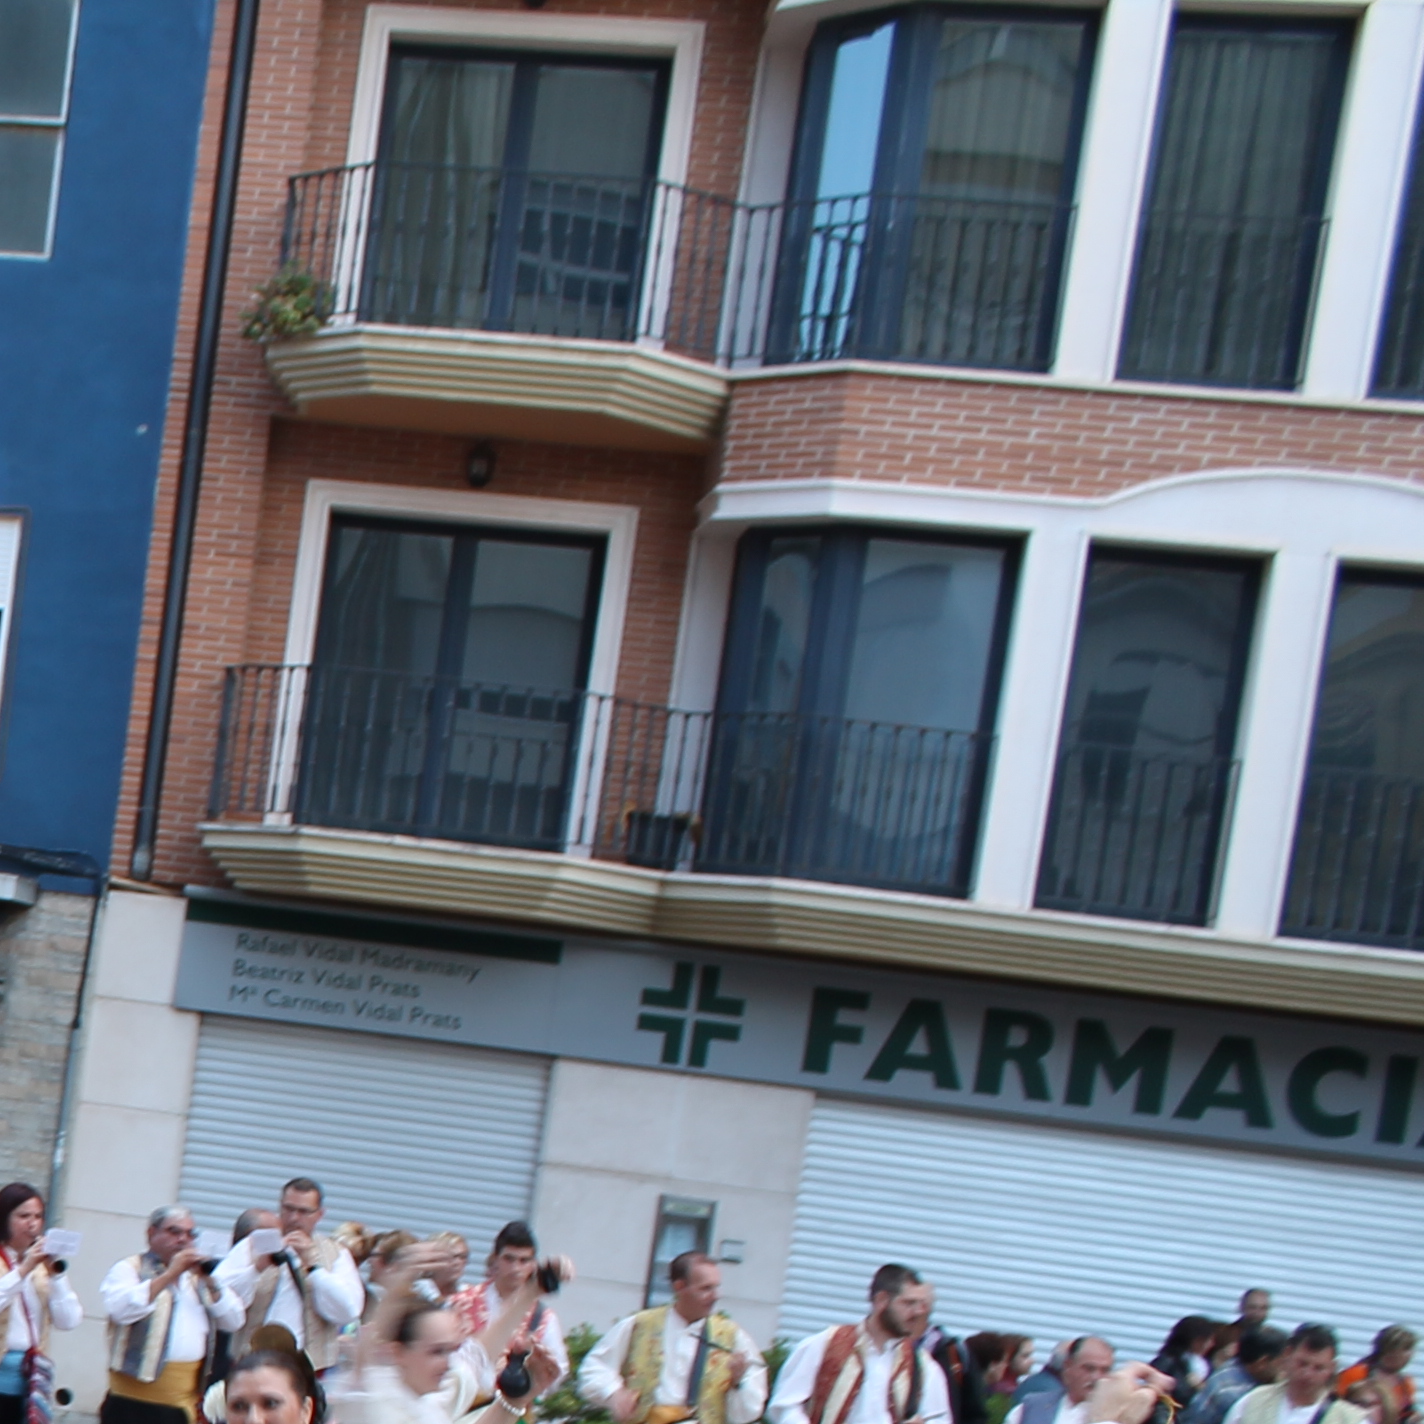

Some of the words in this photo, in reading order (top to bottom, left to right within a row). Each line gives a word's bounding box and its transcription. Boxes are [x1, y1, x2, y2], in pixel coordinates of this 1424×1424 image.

[236, 932, 297, 958] Rafael
[304, 941, 353, 964] Vidal
[232, 958, 305, 985] Beatriz
[311, 967, 361, 991] Vidal
[368, 974, 421, 999] Prats
[263, 988, 344, 1015] Carmen
[353, 999, 402, 1022] Vidal
[409, 1006, 462, 1030] Prats
[802, 987, 1424, 1147] FARMACI
